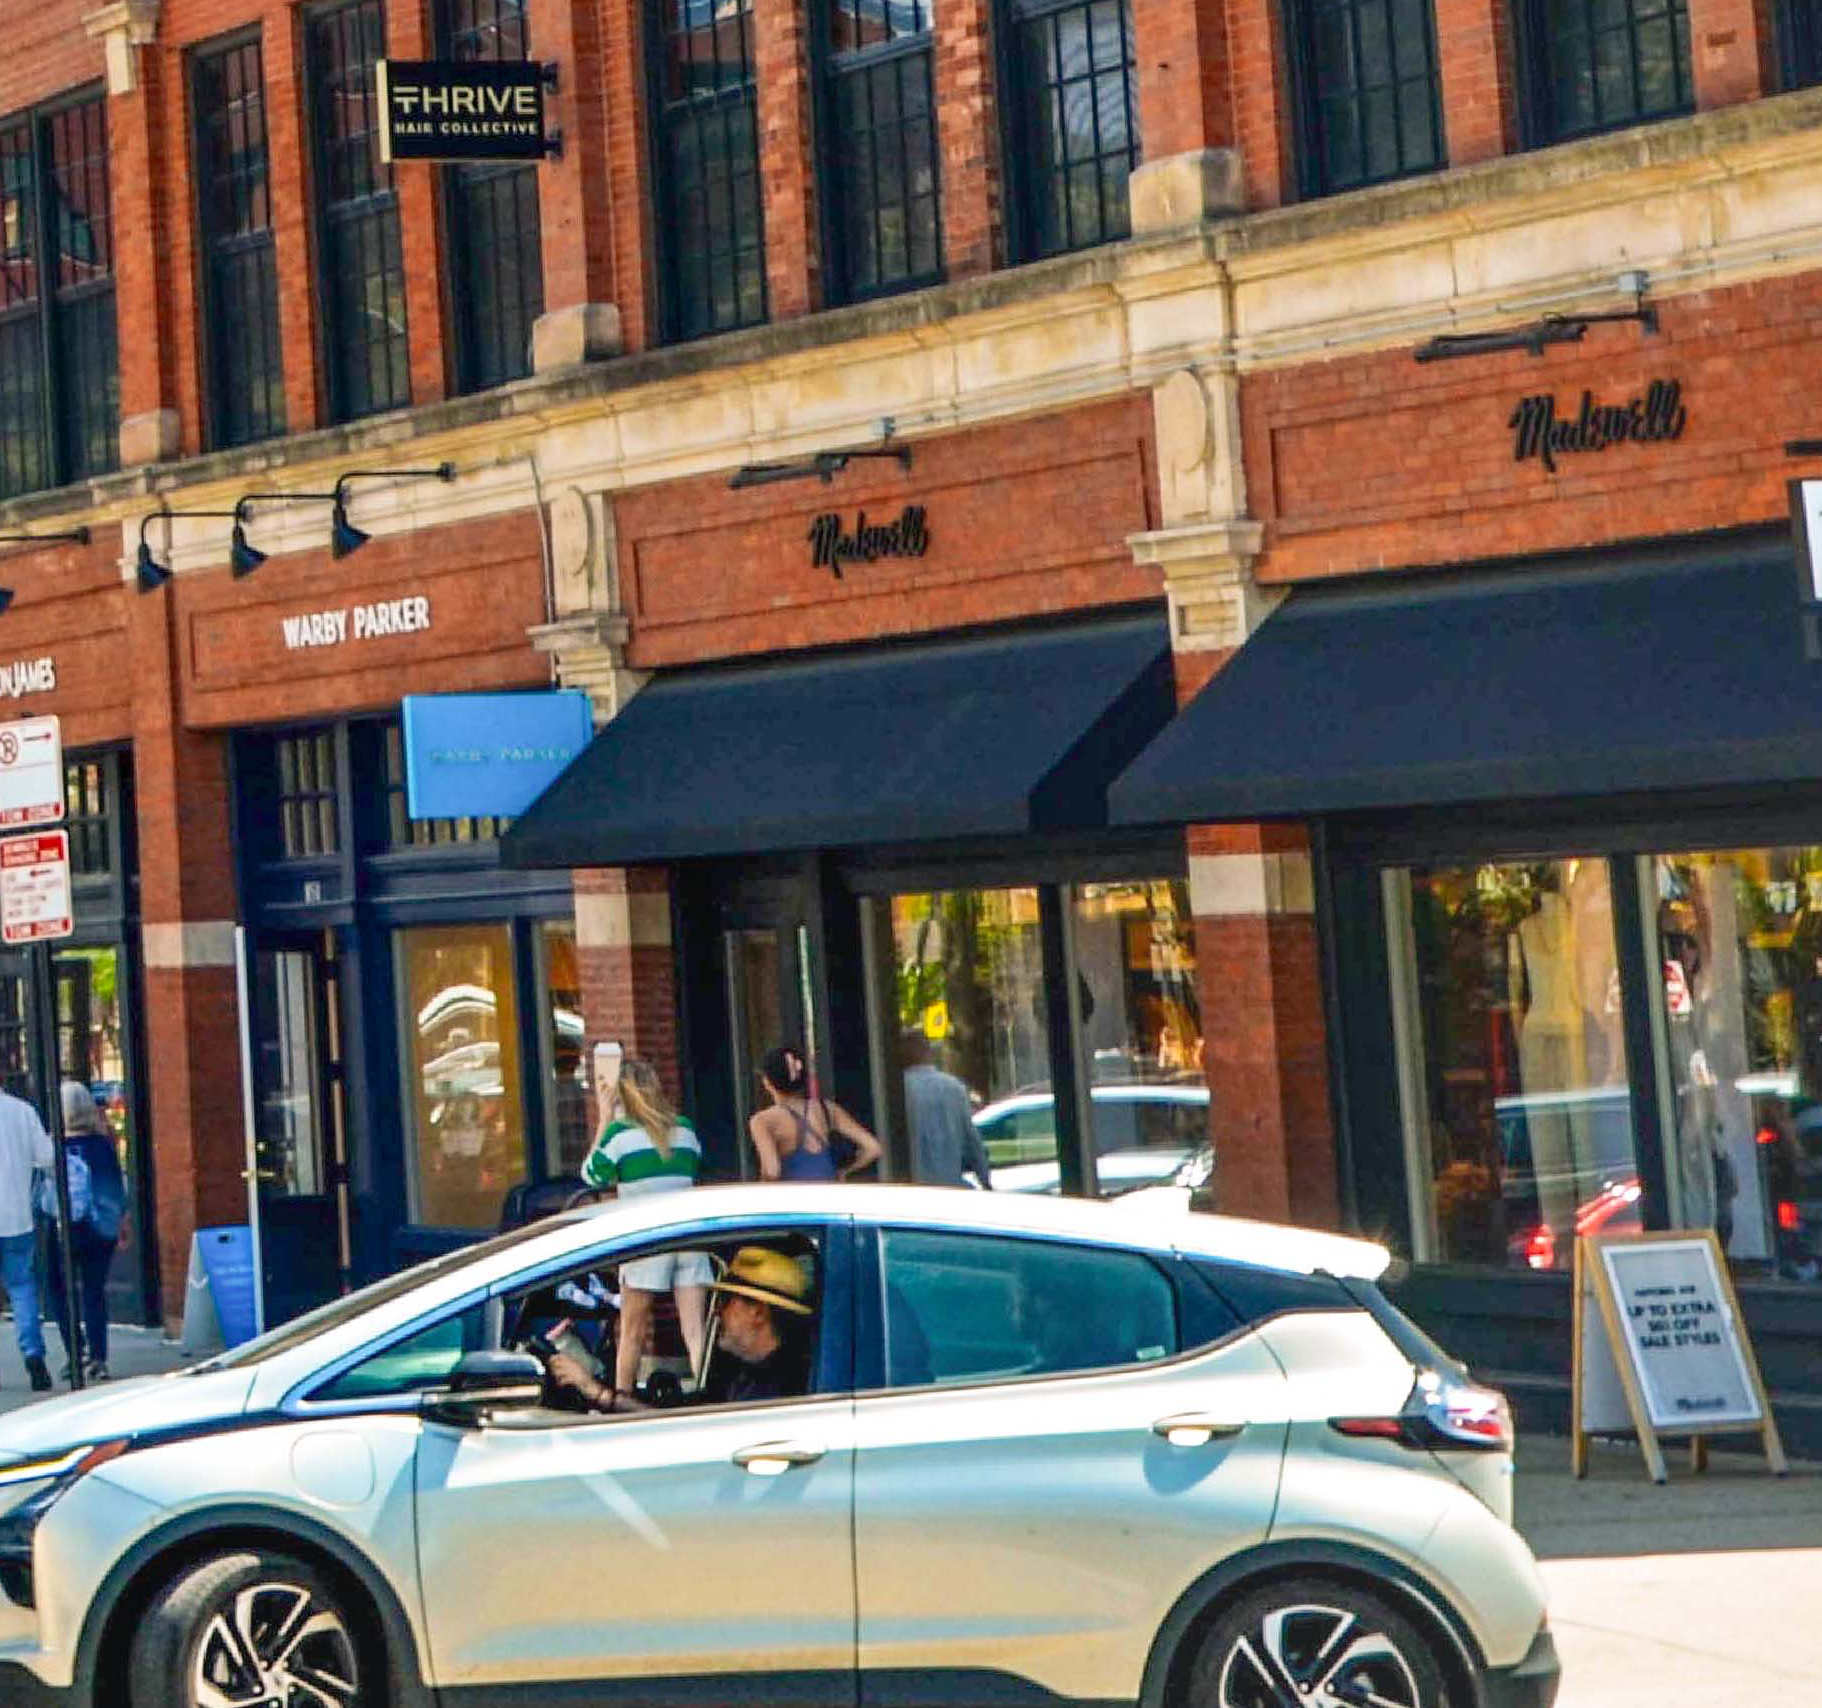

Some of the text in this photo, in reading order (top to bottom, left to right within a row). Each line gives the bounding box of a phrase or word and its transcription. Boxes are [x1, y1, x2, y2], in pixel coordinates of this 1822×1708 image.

[393, 85, 538, 115] THRIVE
[395, 122, 539, 136] HAIR COLLECTIVE
[1508, 377, 1686, 473] Madewell
[283, 596, 430, 650] WARBY PARKER
